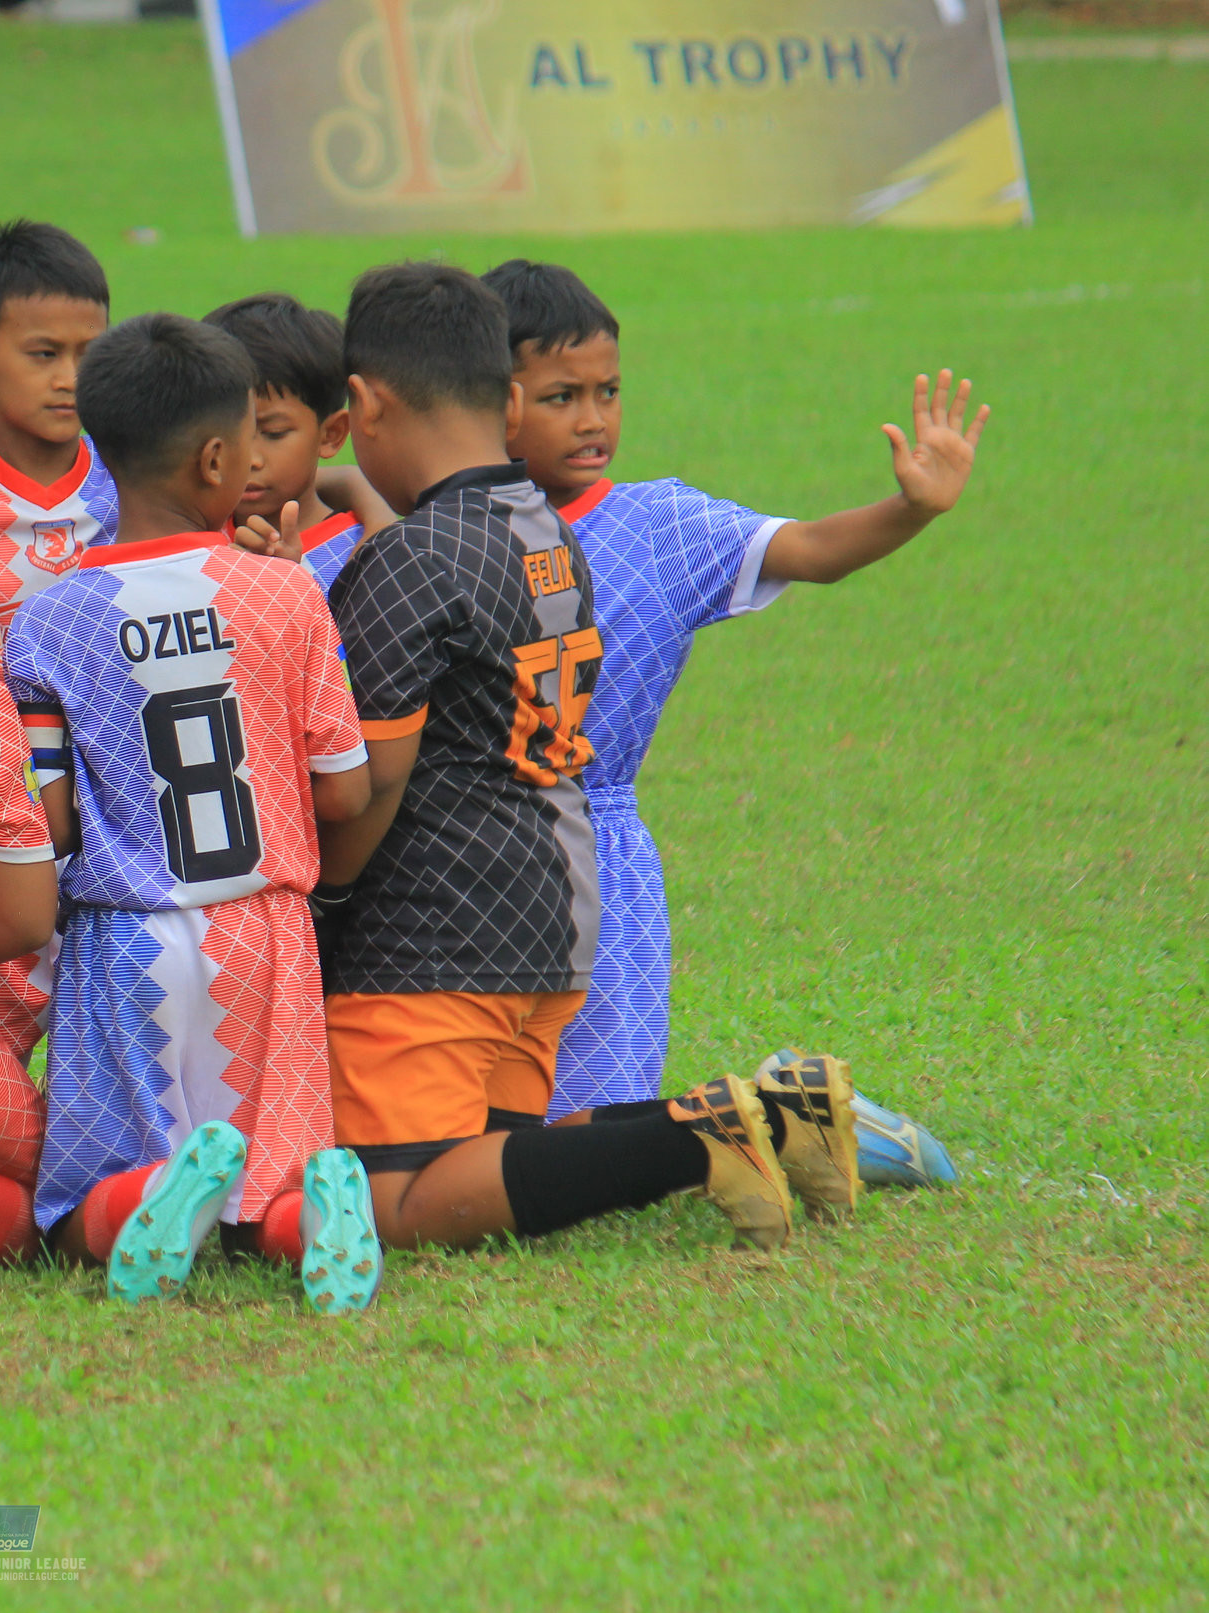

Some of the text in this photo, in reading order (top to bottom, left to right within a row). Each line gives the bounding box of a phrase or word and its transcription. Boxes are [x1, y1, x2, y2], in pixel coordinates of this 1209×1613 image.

[530, 34, 911, 89] AL TROPHY
[523, 546, 576, 598] FELIX
[120, 606, 236, 662] OZIEL
[143, 682, 262, 883] 8
